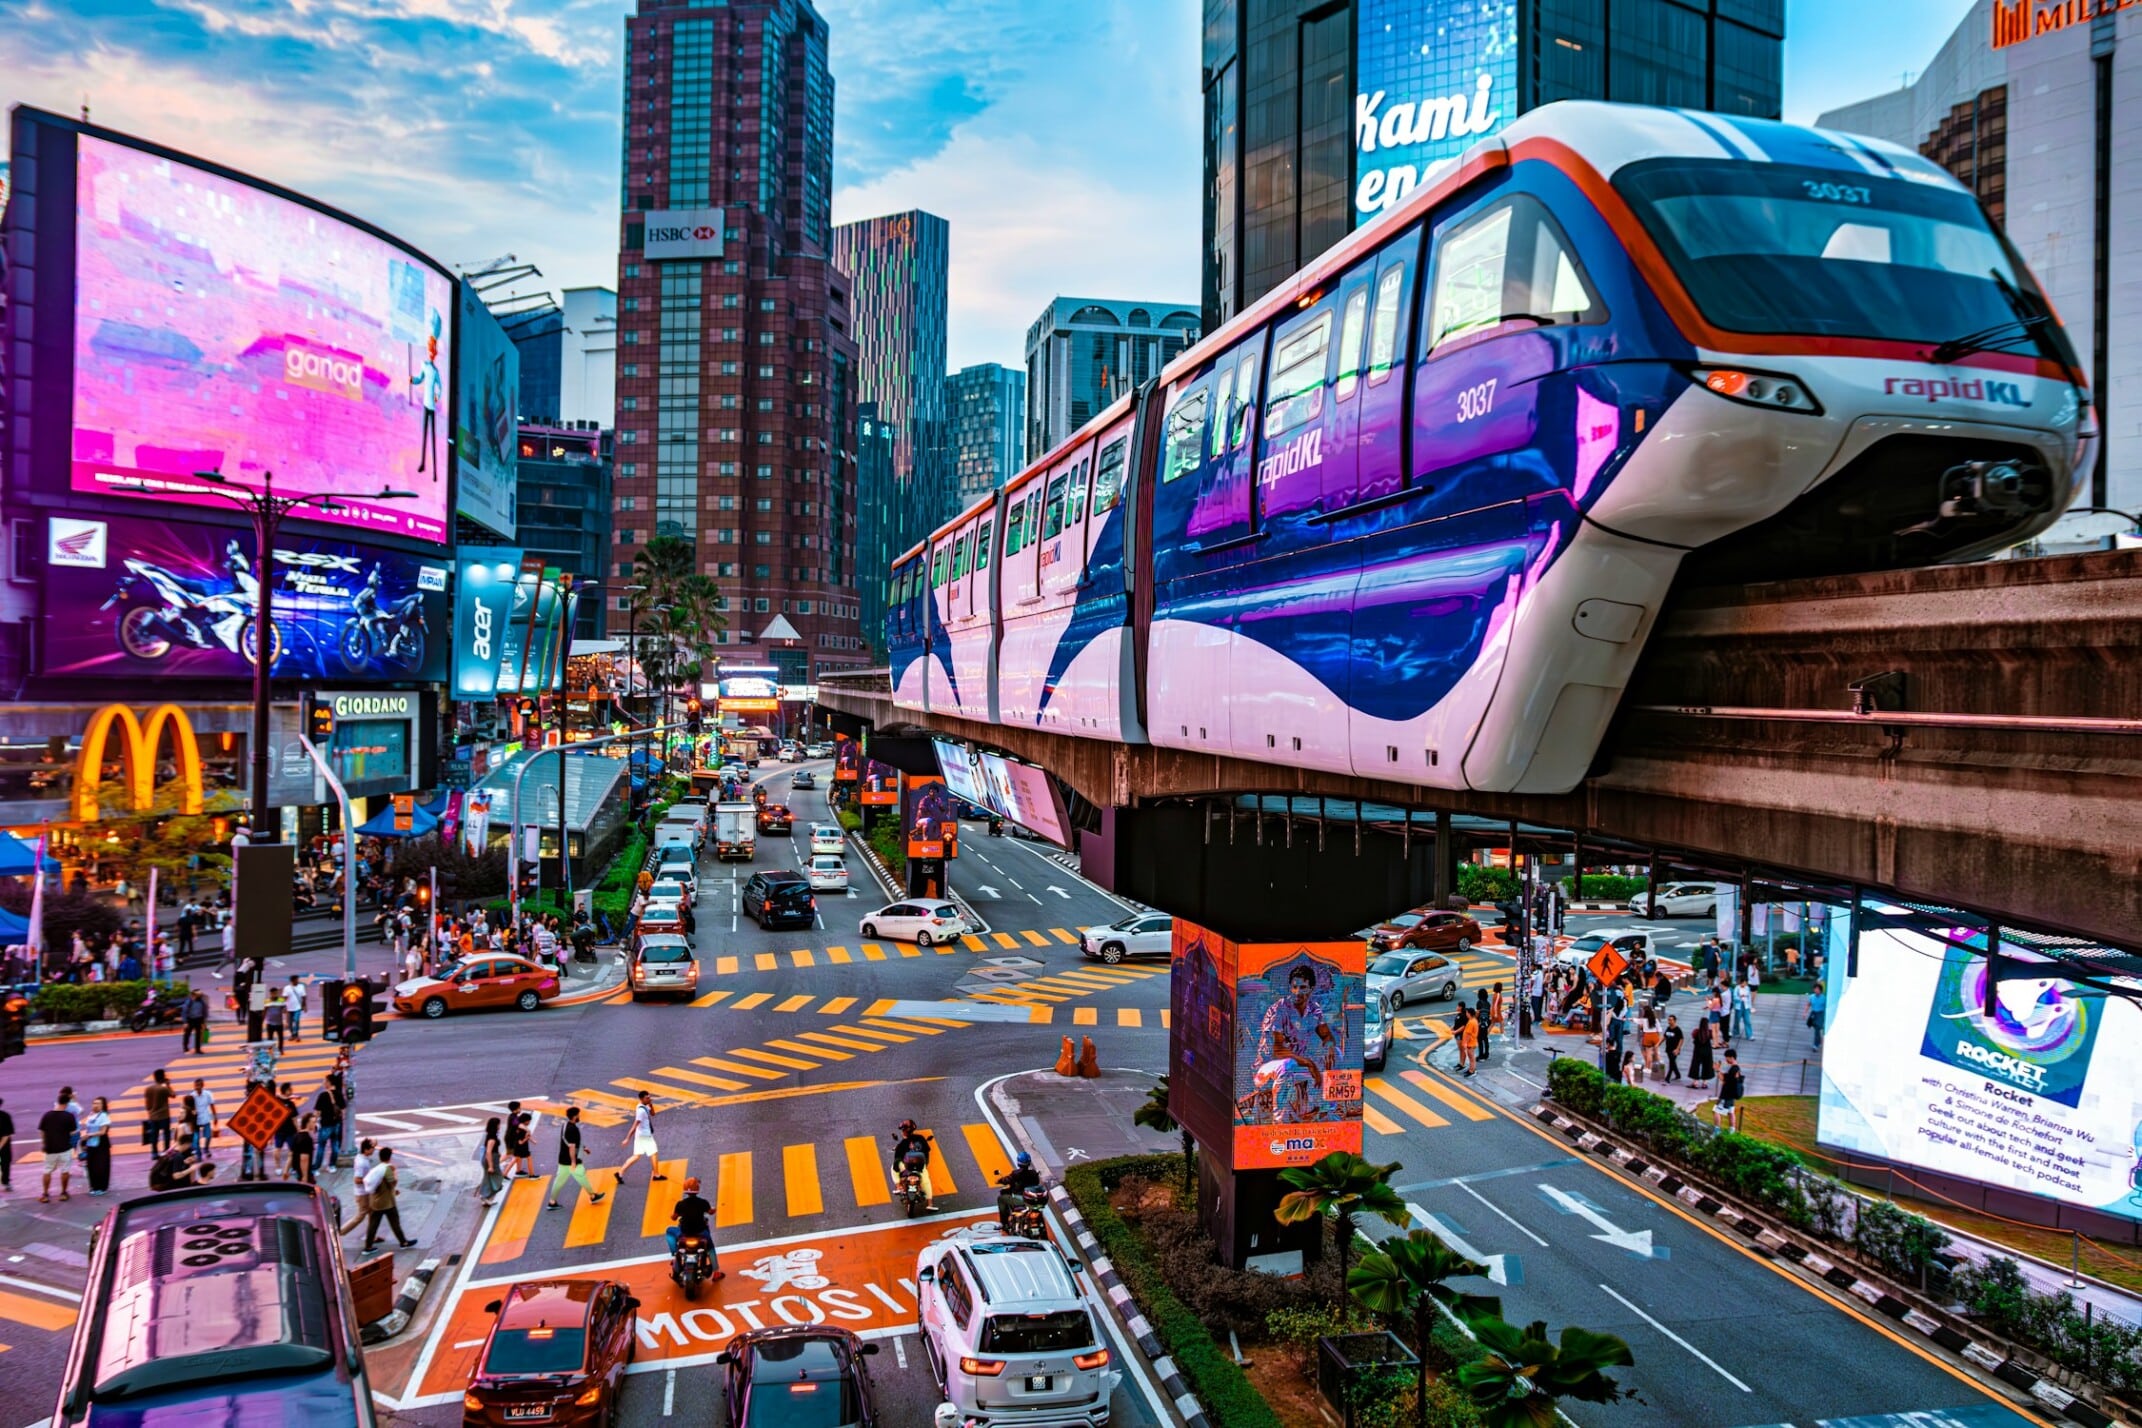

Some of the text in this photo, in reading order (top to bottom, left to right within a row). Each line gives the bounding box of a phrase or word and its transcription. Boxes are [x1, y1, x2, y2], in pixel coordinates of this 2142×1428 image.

[1356, 74, 1500, 152] Kami
[1802, 180, 1871, 204] 3037
[648, 226, 691, 242] HSBC
[286, 349, 361, 388] ganad
[1456, 378, 1498, 423] 3037
[1884, 376, 2032, 408] rapidKL
[1256, 427, 1323, 490] rapidKL
[473, 597, 492, 661] acer
[335, 696, 408, 716] GIORDANO
[1956, 1040, 2048, 1083] ROCKET
[1328, 1085, 1356, 1099] RM59
[1922, 1076, 1943, 1088] with
[1944, 1083, 1988, 1106] Christina
[2032, 1114, 2074, 1136] Brianna
[2076, 1129, 2096, 1143] Wu
[1984, 1081, 2034, 1108] Rocket
[1928, 1103, 2086, 1167] Geek out about tech and geek
[1944, 1096, 2063, 1145] & Simone de Rochefort
[1918, 1125, 2084, 1194] popular all-female tech podcast.
[1928, 1116, 2081, 1179] culture with the first and most
